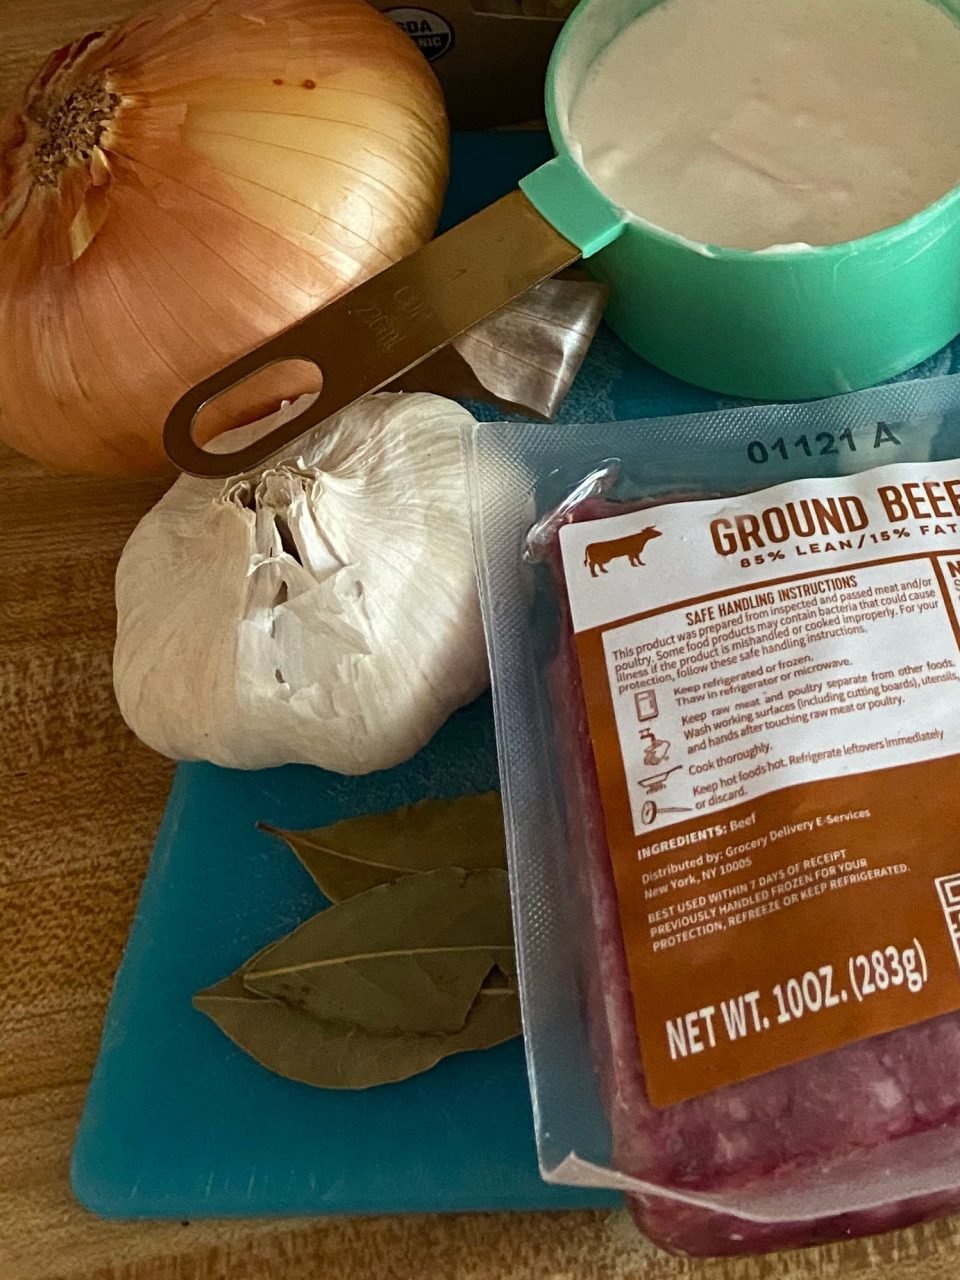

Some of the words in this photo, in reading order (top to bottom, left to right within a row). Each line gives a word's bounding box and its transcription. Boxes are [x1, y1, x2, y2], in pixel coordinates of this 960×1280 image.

[747, 427, 857, 465] 01121
[873, 422, 902, 449] A
[709, 494, 869, 556] GROUND
[739, 548, 789, 569] 85%
[796, 525, 911, 556] LEAN/15%
[919, 522, 959, 538] FAT
[685, 606, 715, 626] SAFE
[717, 591, 775, 616] HANDLING
[777, 575, 857, 602] INSTRUCTIONS
[637, 823, 727, 860] INGREDIENTS:
[728, 812, 757, 831] Beef
[642, 855, 703, 884] Distributed
[705, 849, 723, 864] by:
[725, 835, 769, 857] Grocery
[768, 818, 816, 840] Delivery
[814, 807, 872, 826] E-Services
[644, 883, 668, 900] New
[670, 872, 700, 892] York,
[702, 867, 717, 880] NY
[719, 856, 752, 874] 10005
[665, 1005, 719, 1062] NET
[720, 989, 770, 1044] WT.
[848, 938, 928, 1002] (283g)
